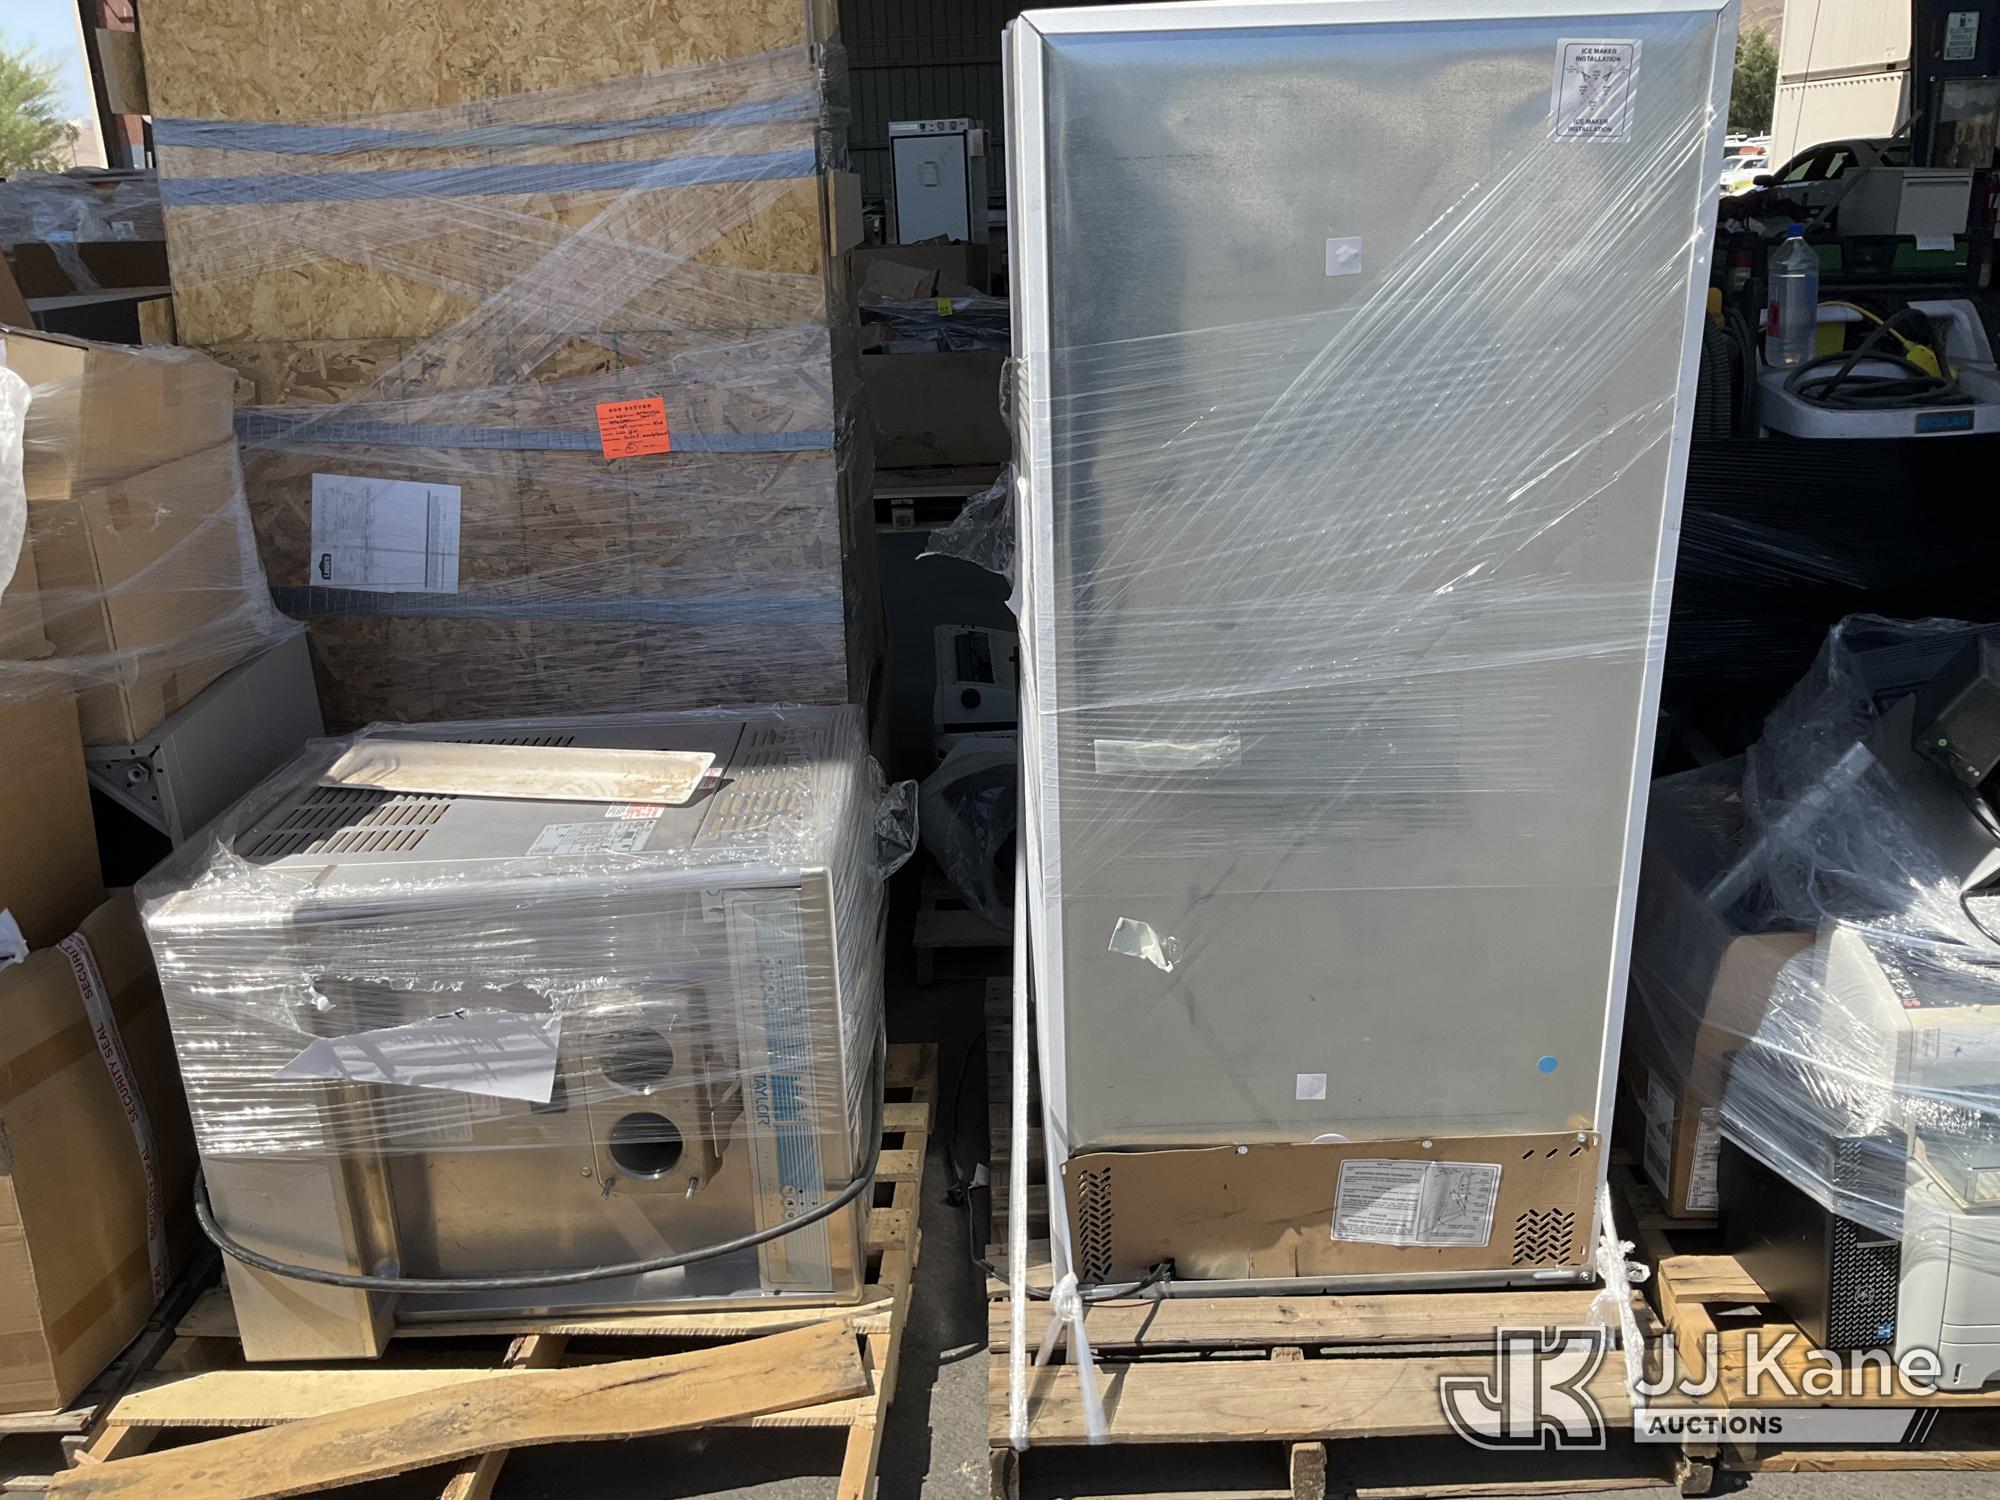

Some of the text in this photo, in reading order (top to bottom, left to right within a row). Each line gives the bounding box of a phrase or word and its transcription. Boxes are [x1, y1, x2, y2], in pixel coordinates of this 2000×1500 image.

[96, 1022, 114, 1059] SEAL
[109, 1062, 138, 1123] SECURITY
[753, 1072, 770, 1126] TAYLOR
